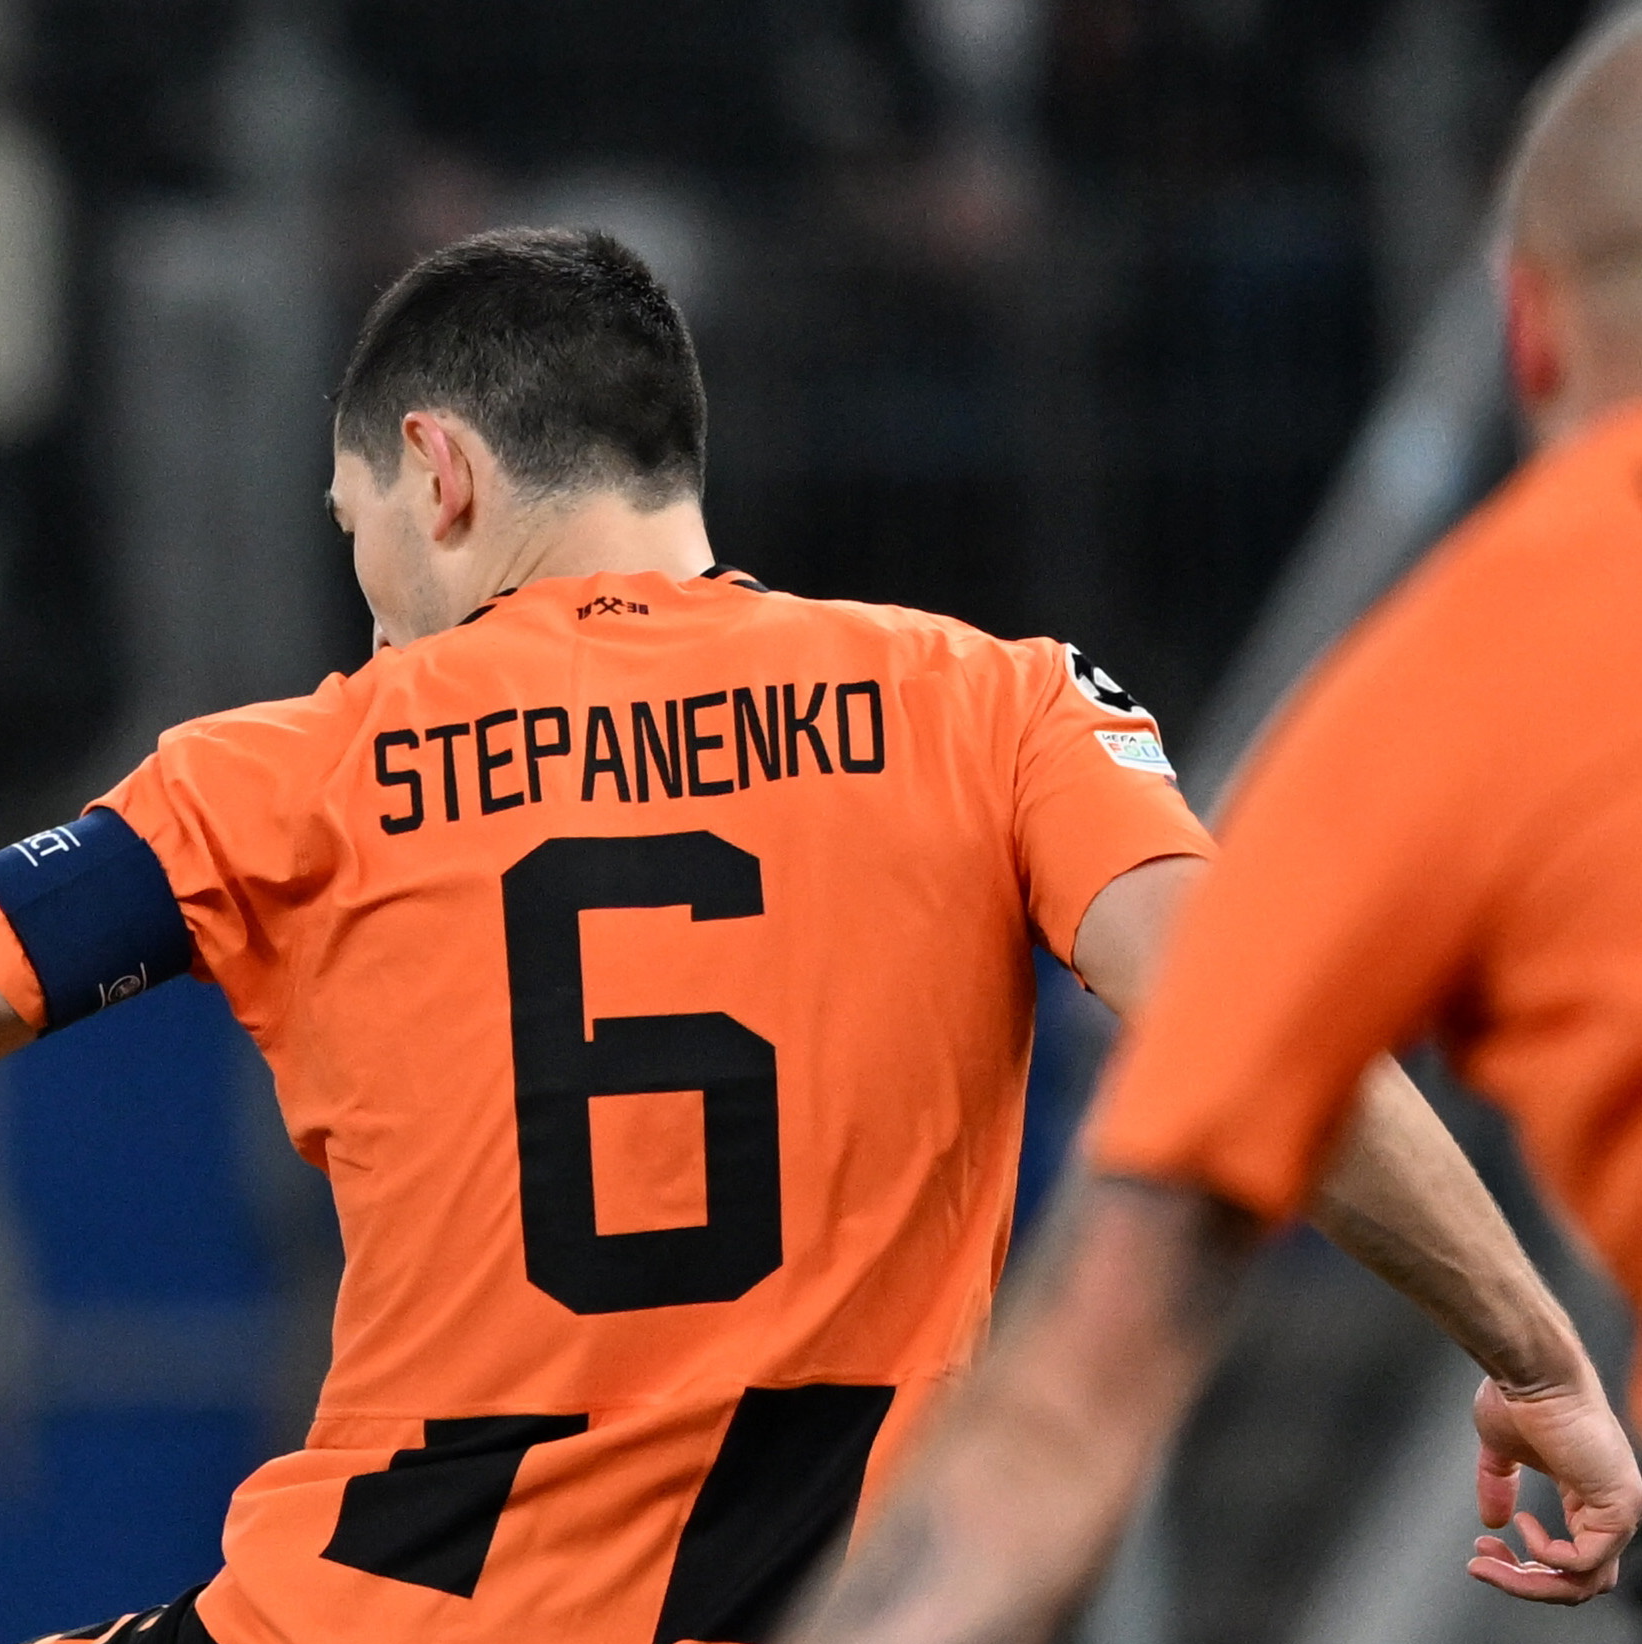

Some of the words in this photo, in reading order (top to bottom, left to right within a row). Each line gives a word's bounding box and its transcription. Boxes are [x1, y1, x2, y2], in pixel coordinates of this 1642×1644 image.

[373, 680, 884, 835] STEPANENKO
[1102, 734, 1137, 744] UEFA
[501, 830, 783, 1315] 6
